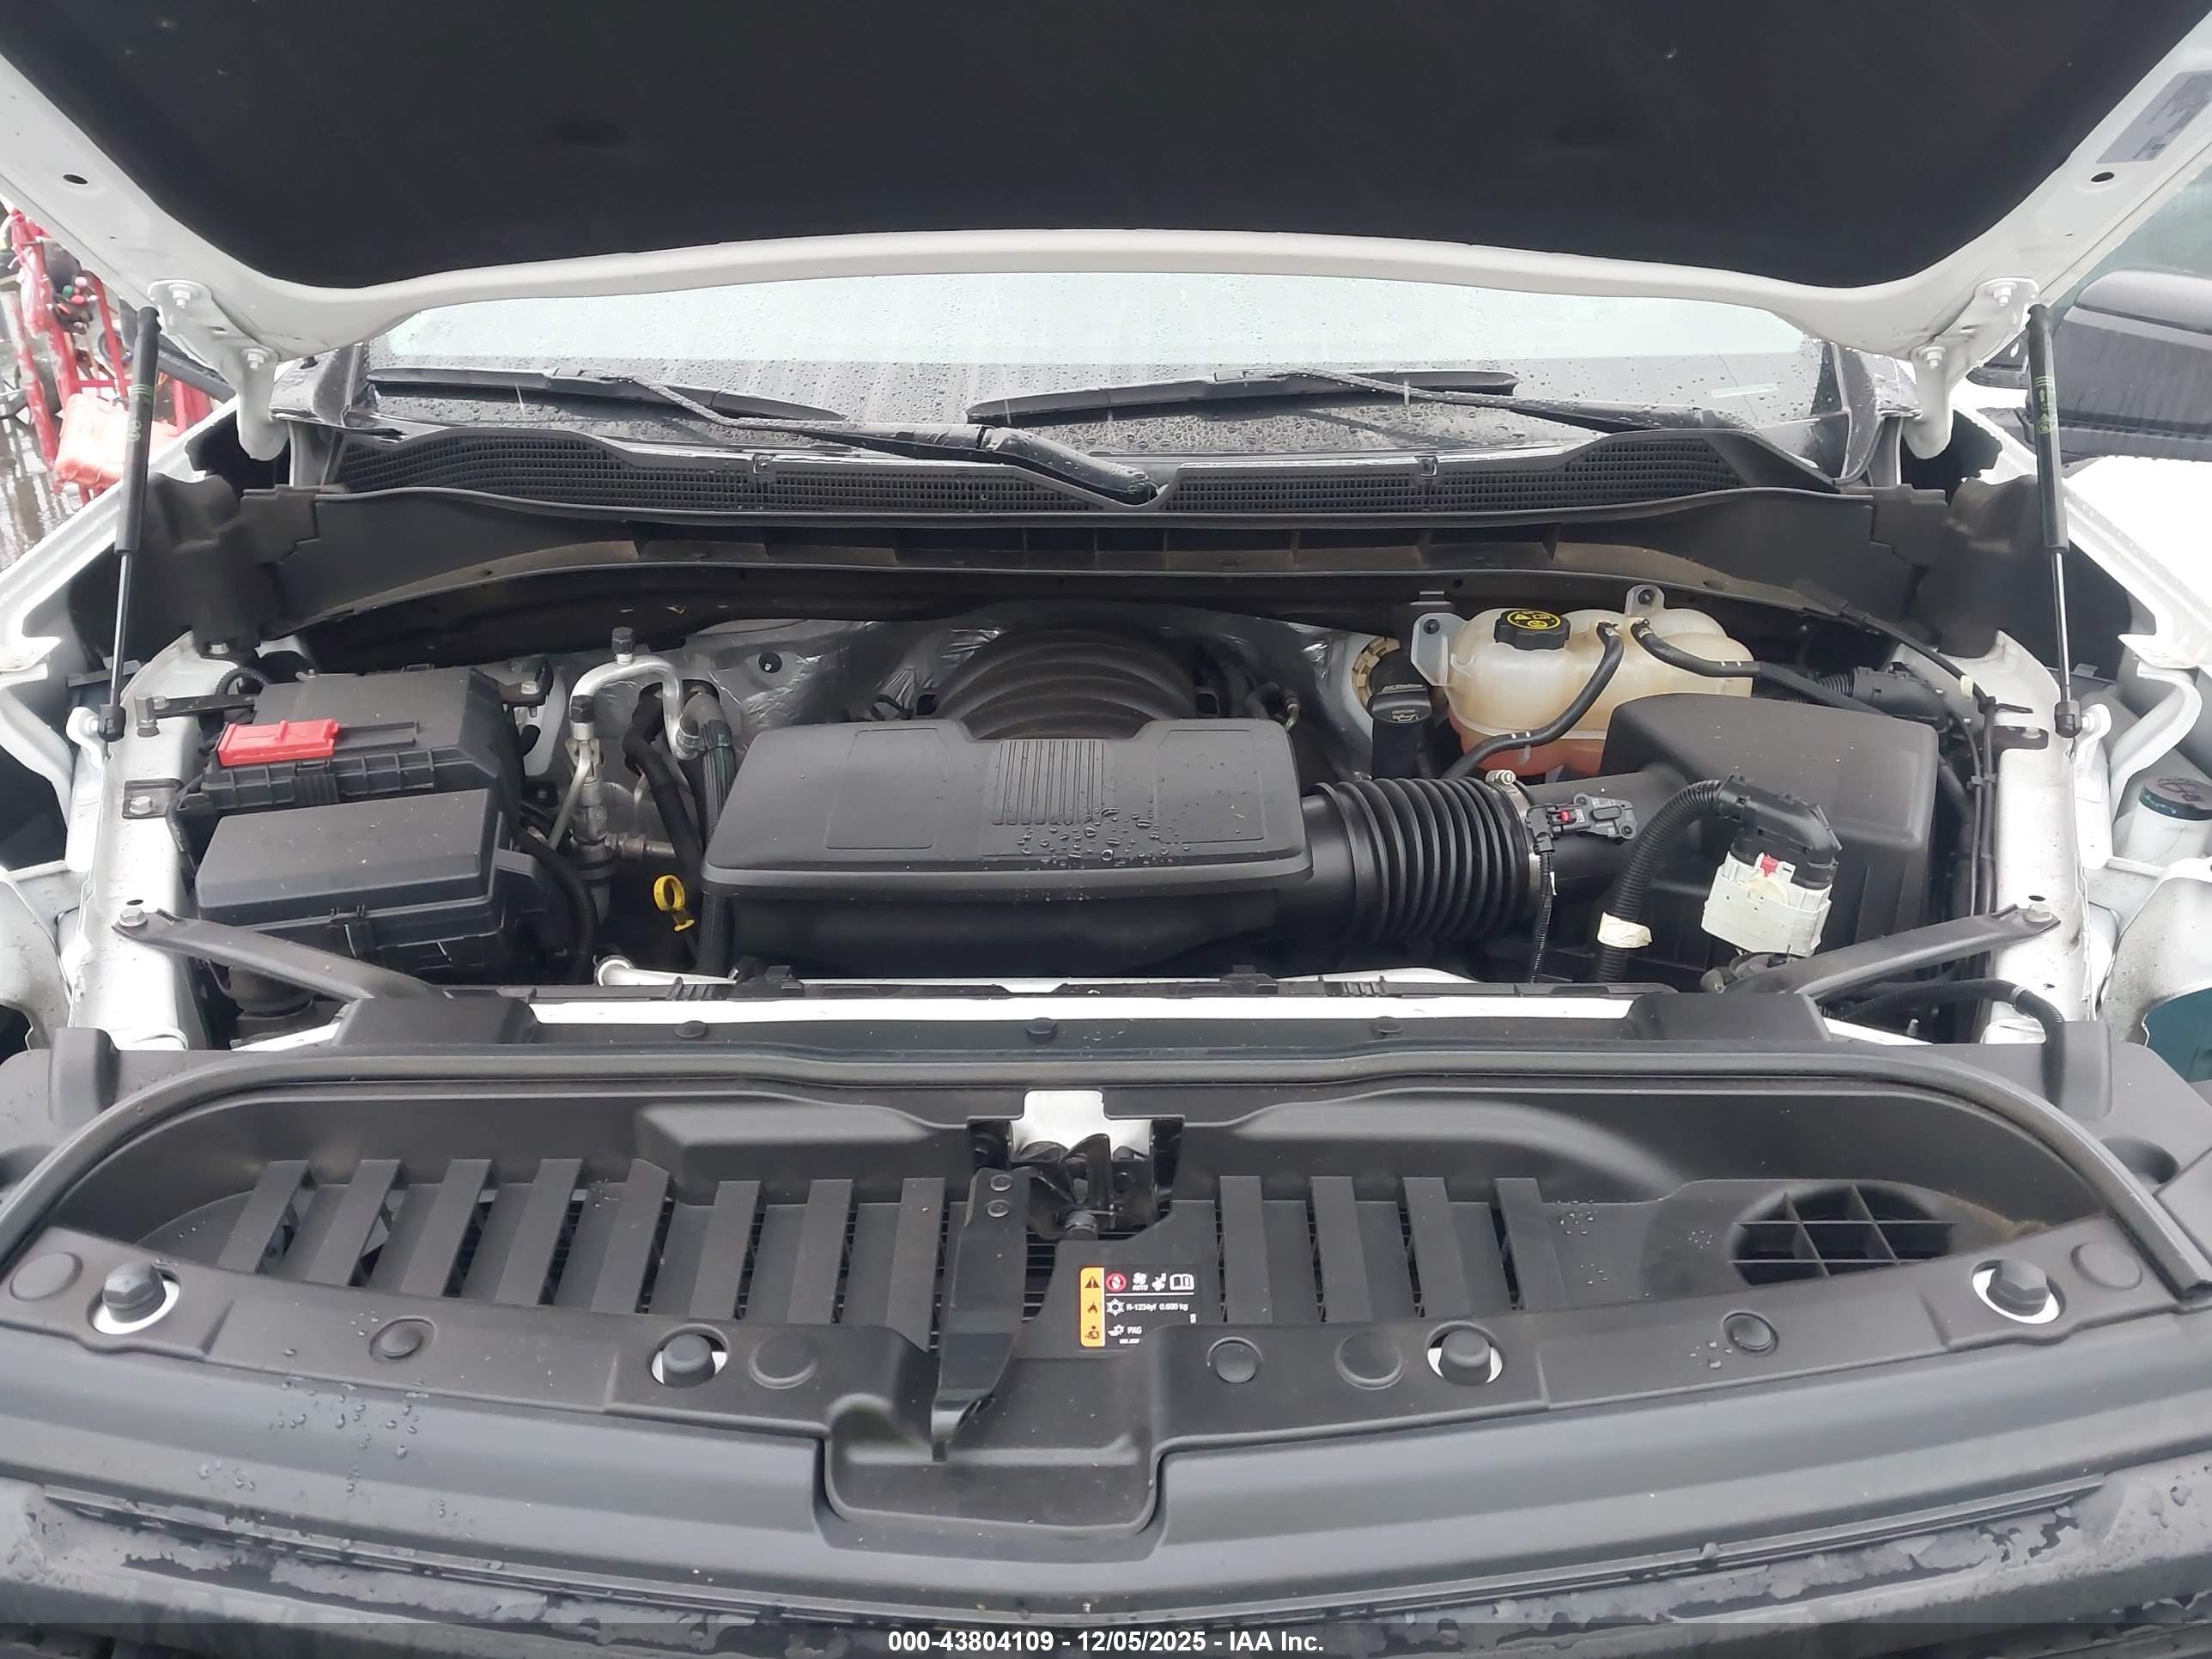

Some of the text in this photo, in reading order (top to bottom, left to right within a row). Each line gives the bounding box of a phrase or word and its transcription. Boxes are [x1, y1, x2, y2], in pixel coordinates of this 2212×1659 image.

[1126, 1303, 1158, 1312] R-1234yf
[1179, 1303, 1189, 1312] kg
[1127, 1326, 1143, 1334] PAG
